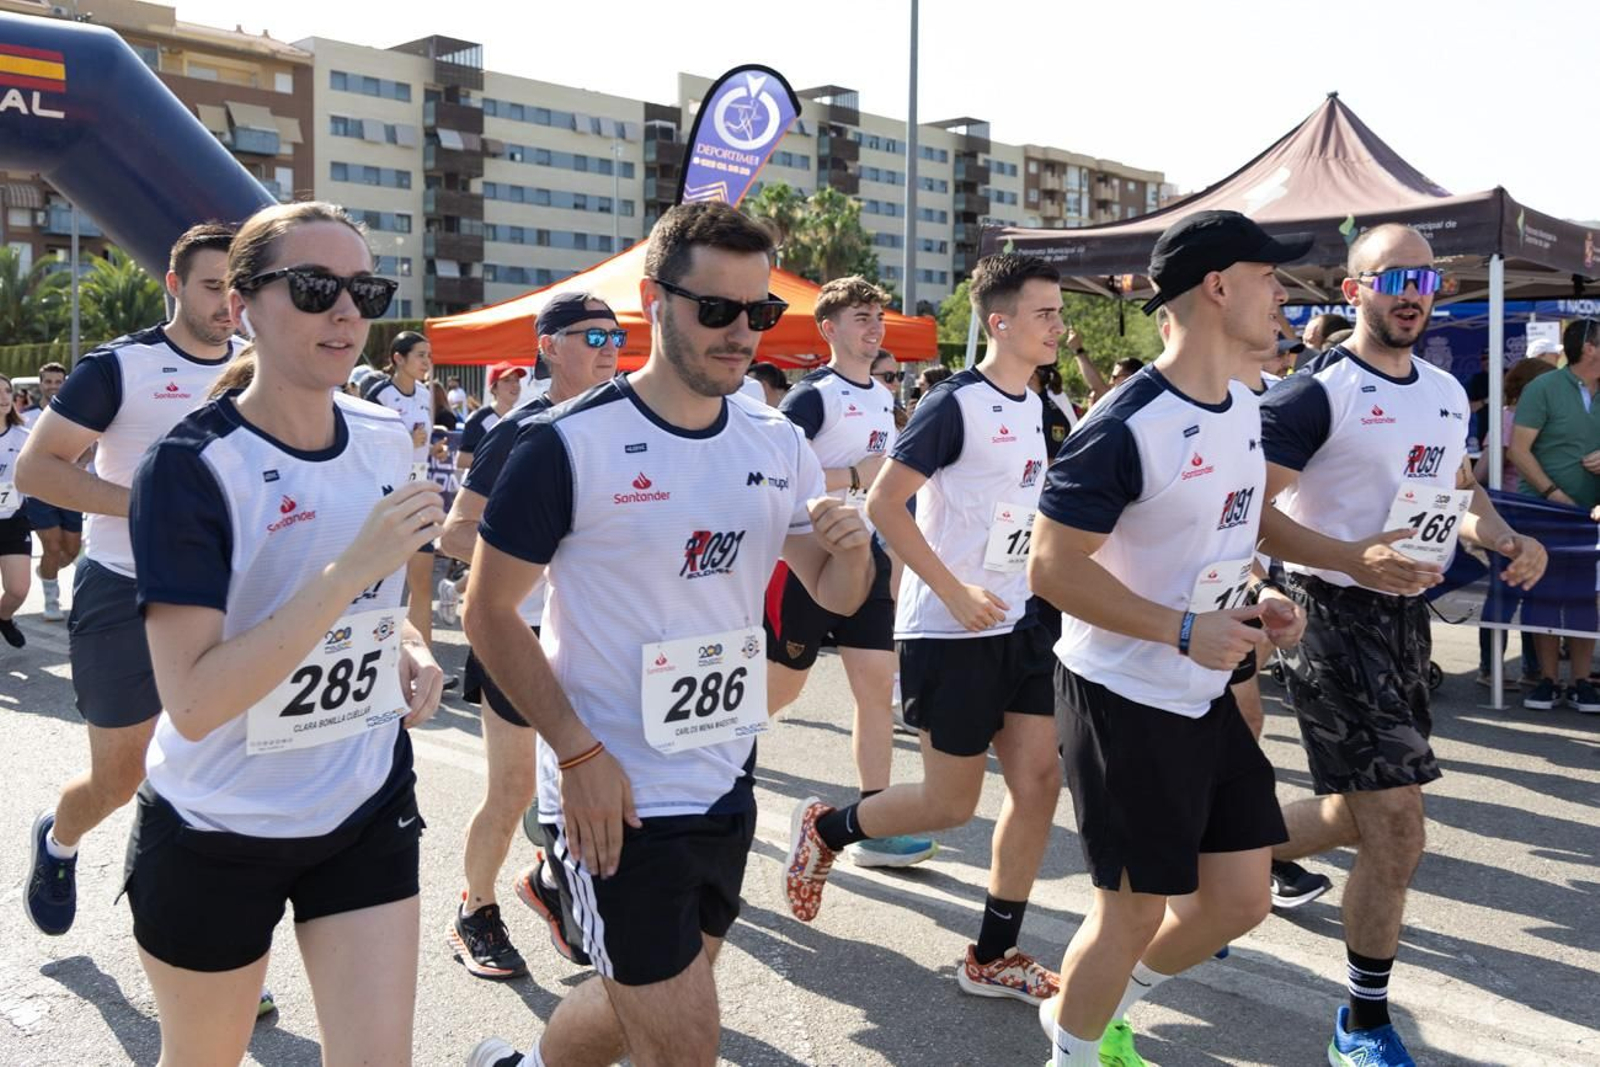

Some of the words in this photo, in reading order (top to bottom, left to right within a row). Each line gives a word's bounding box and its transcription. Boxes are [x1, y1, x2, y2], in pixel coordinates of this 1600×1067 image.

[613, 490, 670, 504] Santander
[266, 510, 316, 533] Santander
[1408, 511, 1457, 543] 168
[1007, 529, 1031, 555] 17
[279, 649, 382, 717] 285
[663, 666, 747, 724] 286
[293, 720, 317, 733] CLARA
[318, 716, 346, 729] BONILLA
[675, 725, 699, 737] CARLOS
